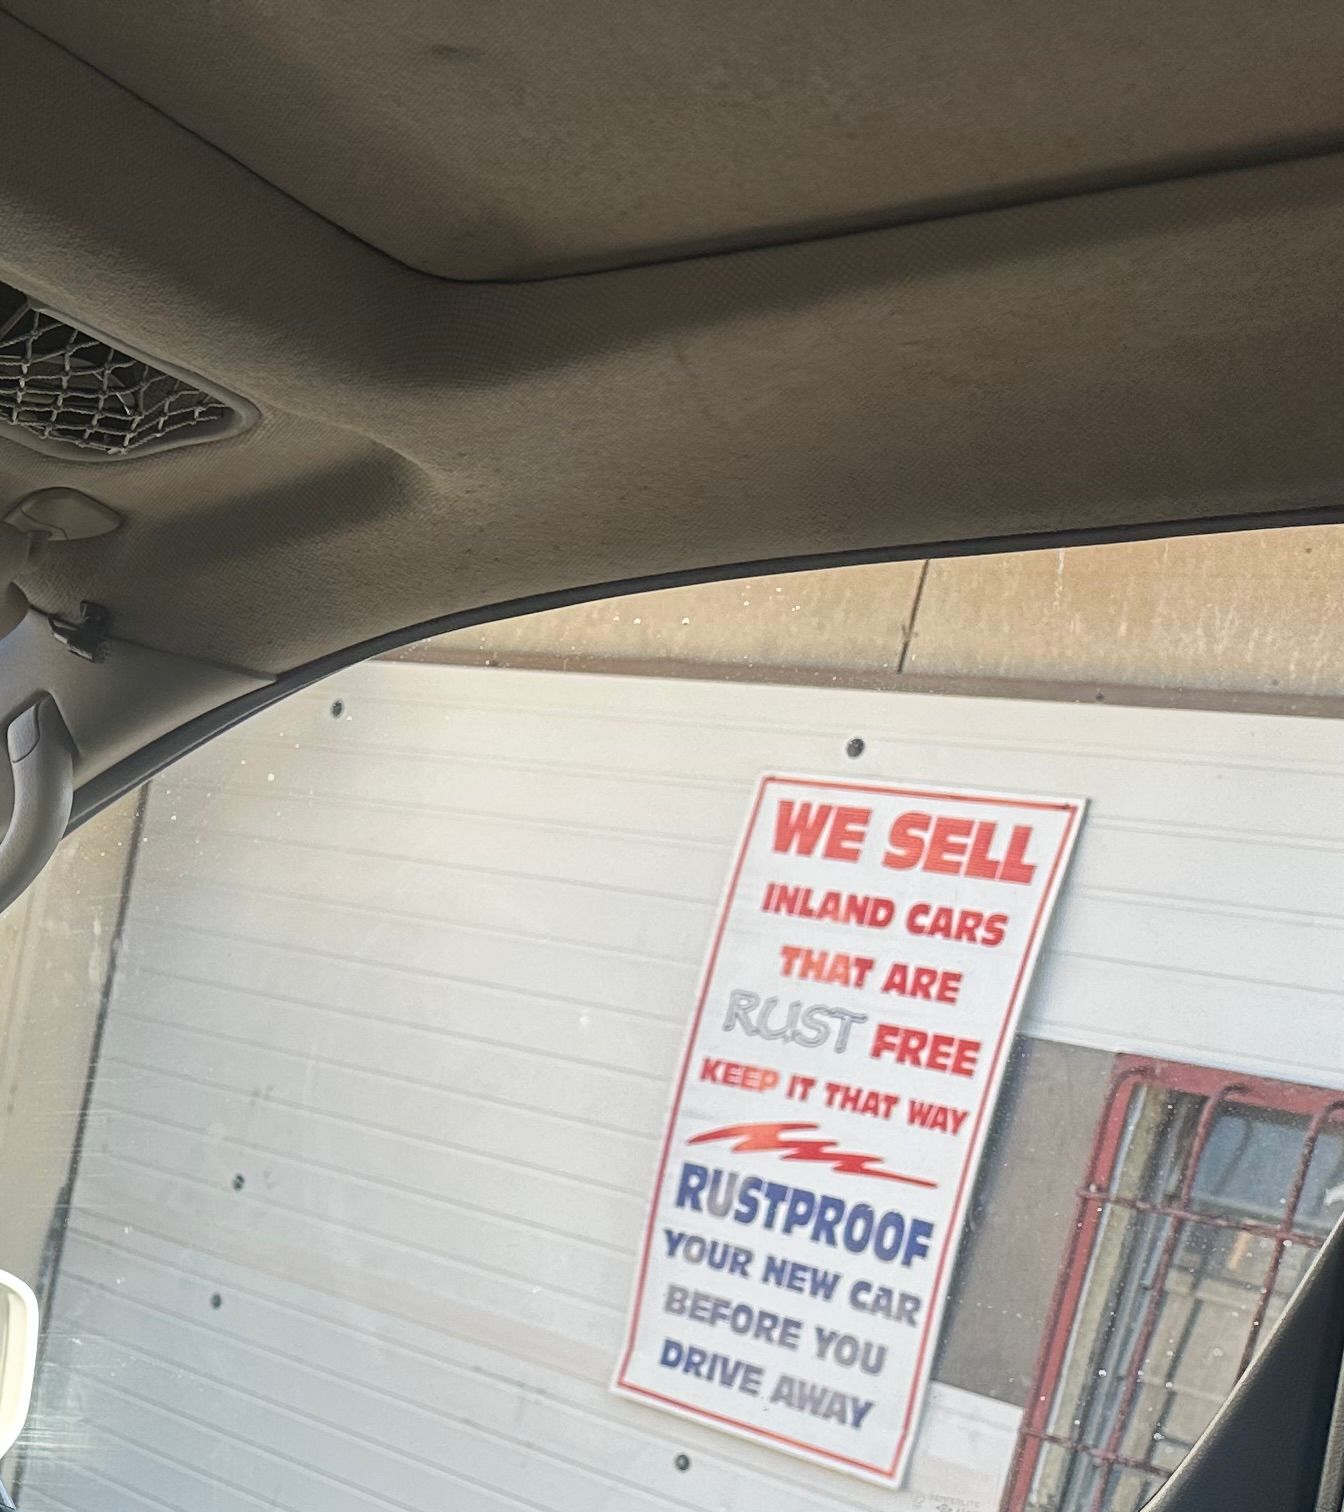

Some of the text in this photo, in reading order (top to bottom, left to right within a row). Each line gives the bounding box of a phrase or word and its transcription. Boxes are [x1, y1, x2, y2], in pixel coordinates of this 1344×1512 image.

[772, 800, 1037, 886] WE SELL
[762, 883, 1009, 947] INLAND CARS
[780, 945, 963, 1005] THAT ARE
[722, 988, 982, 1079] RUST FREE
[700, 1058, 970, 1136] KEEP IT THAT WAY
[675, 1162, 934, 1268] RUSTPROOF
[664, 1229, 921, 1328] YOUR NEW CAR
[664, 1283, 887, 1377] BEFORE YOU
[659, 1337, 874, 1429] DRIVE AWAY
